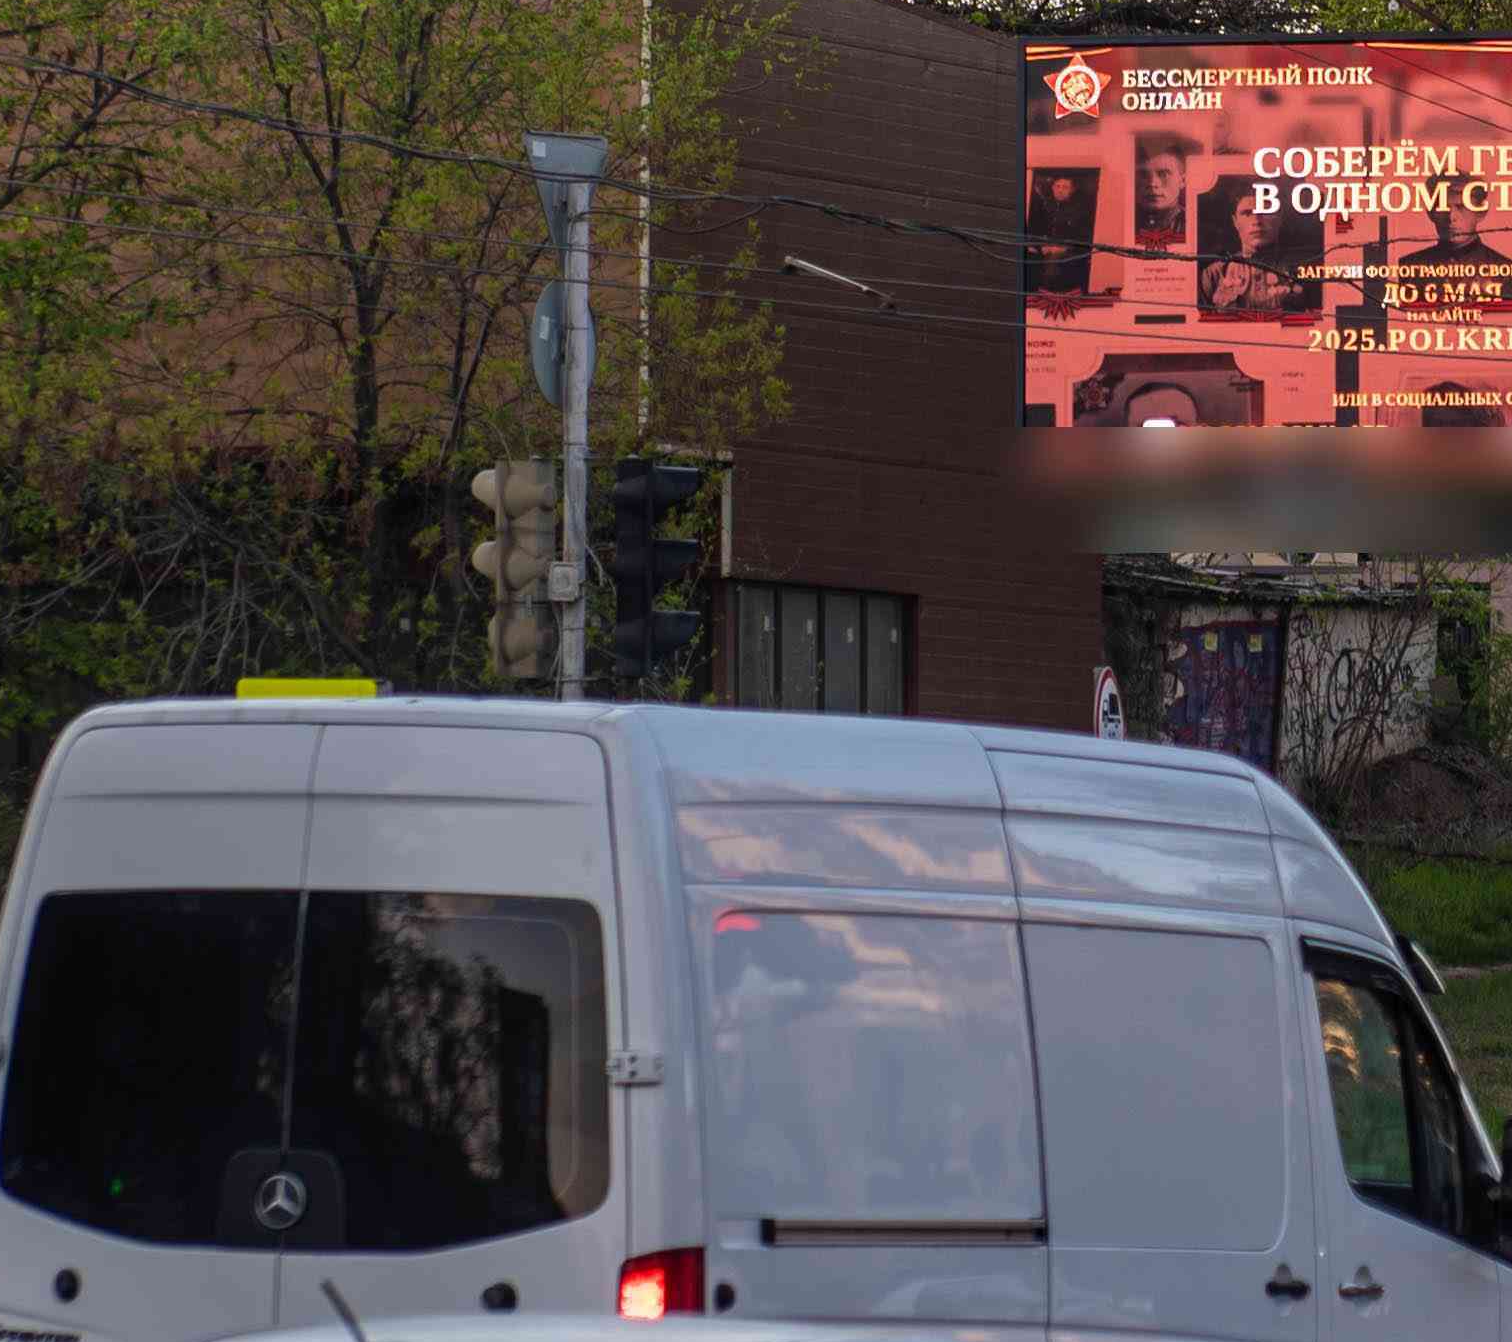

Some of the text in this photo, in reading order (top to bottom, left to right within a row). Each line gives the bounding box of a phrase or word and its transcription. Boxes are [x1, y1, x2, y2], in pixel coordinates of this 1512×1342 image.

[1121, 64, 1374, 88] БЕССМЕРТНЫЙ ПОЛК
[1121, 88, 1223, 110] ОНЛАЙН
[1253, 139, 1460, 178] СОБЕРЁМ
[1252, 183, 1281, 214] В
[1291, 181, 1451, 221] ОДНОМ
[1297, 265, 1363, 279] ЗАГРУЗИ
[1365, 263, 1475, 278] ФОТОГРАФИЮ
[1383, 282, 1419, 309] ДО
[1443, 282, 1503, 303] МАЯ
[1431, 307, 1483, 322] САЙТЕ
[1331, 393, 1368, 407] ИЛИ
[1371, 393, 1383, 407] В
[1385, 392, 1503, 409] СОЦИАЛЬНЫХ
